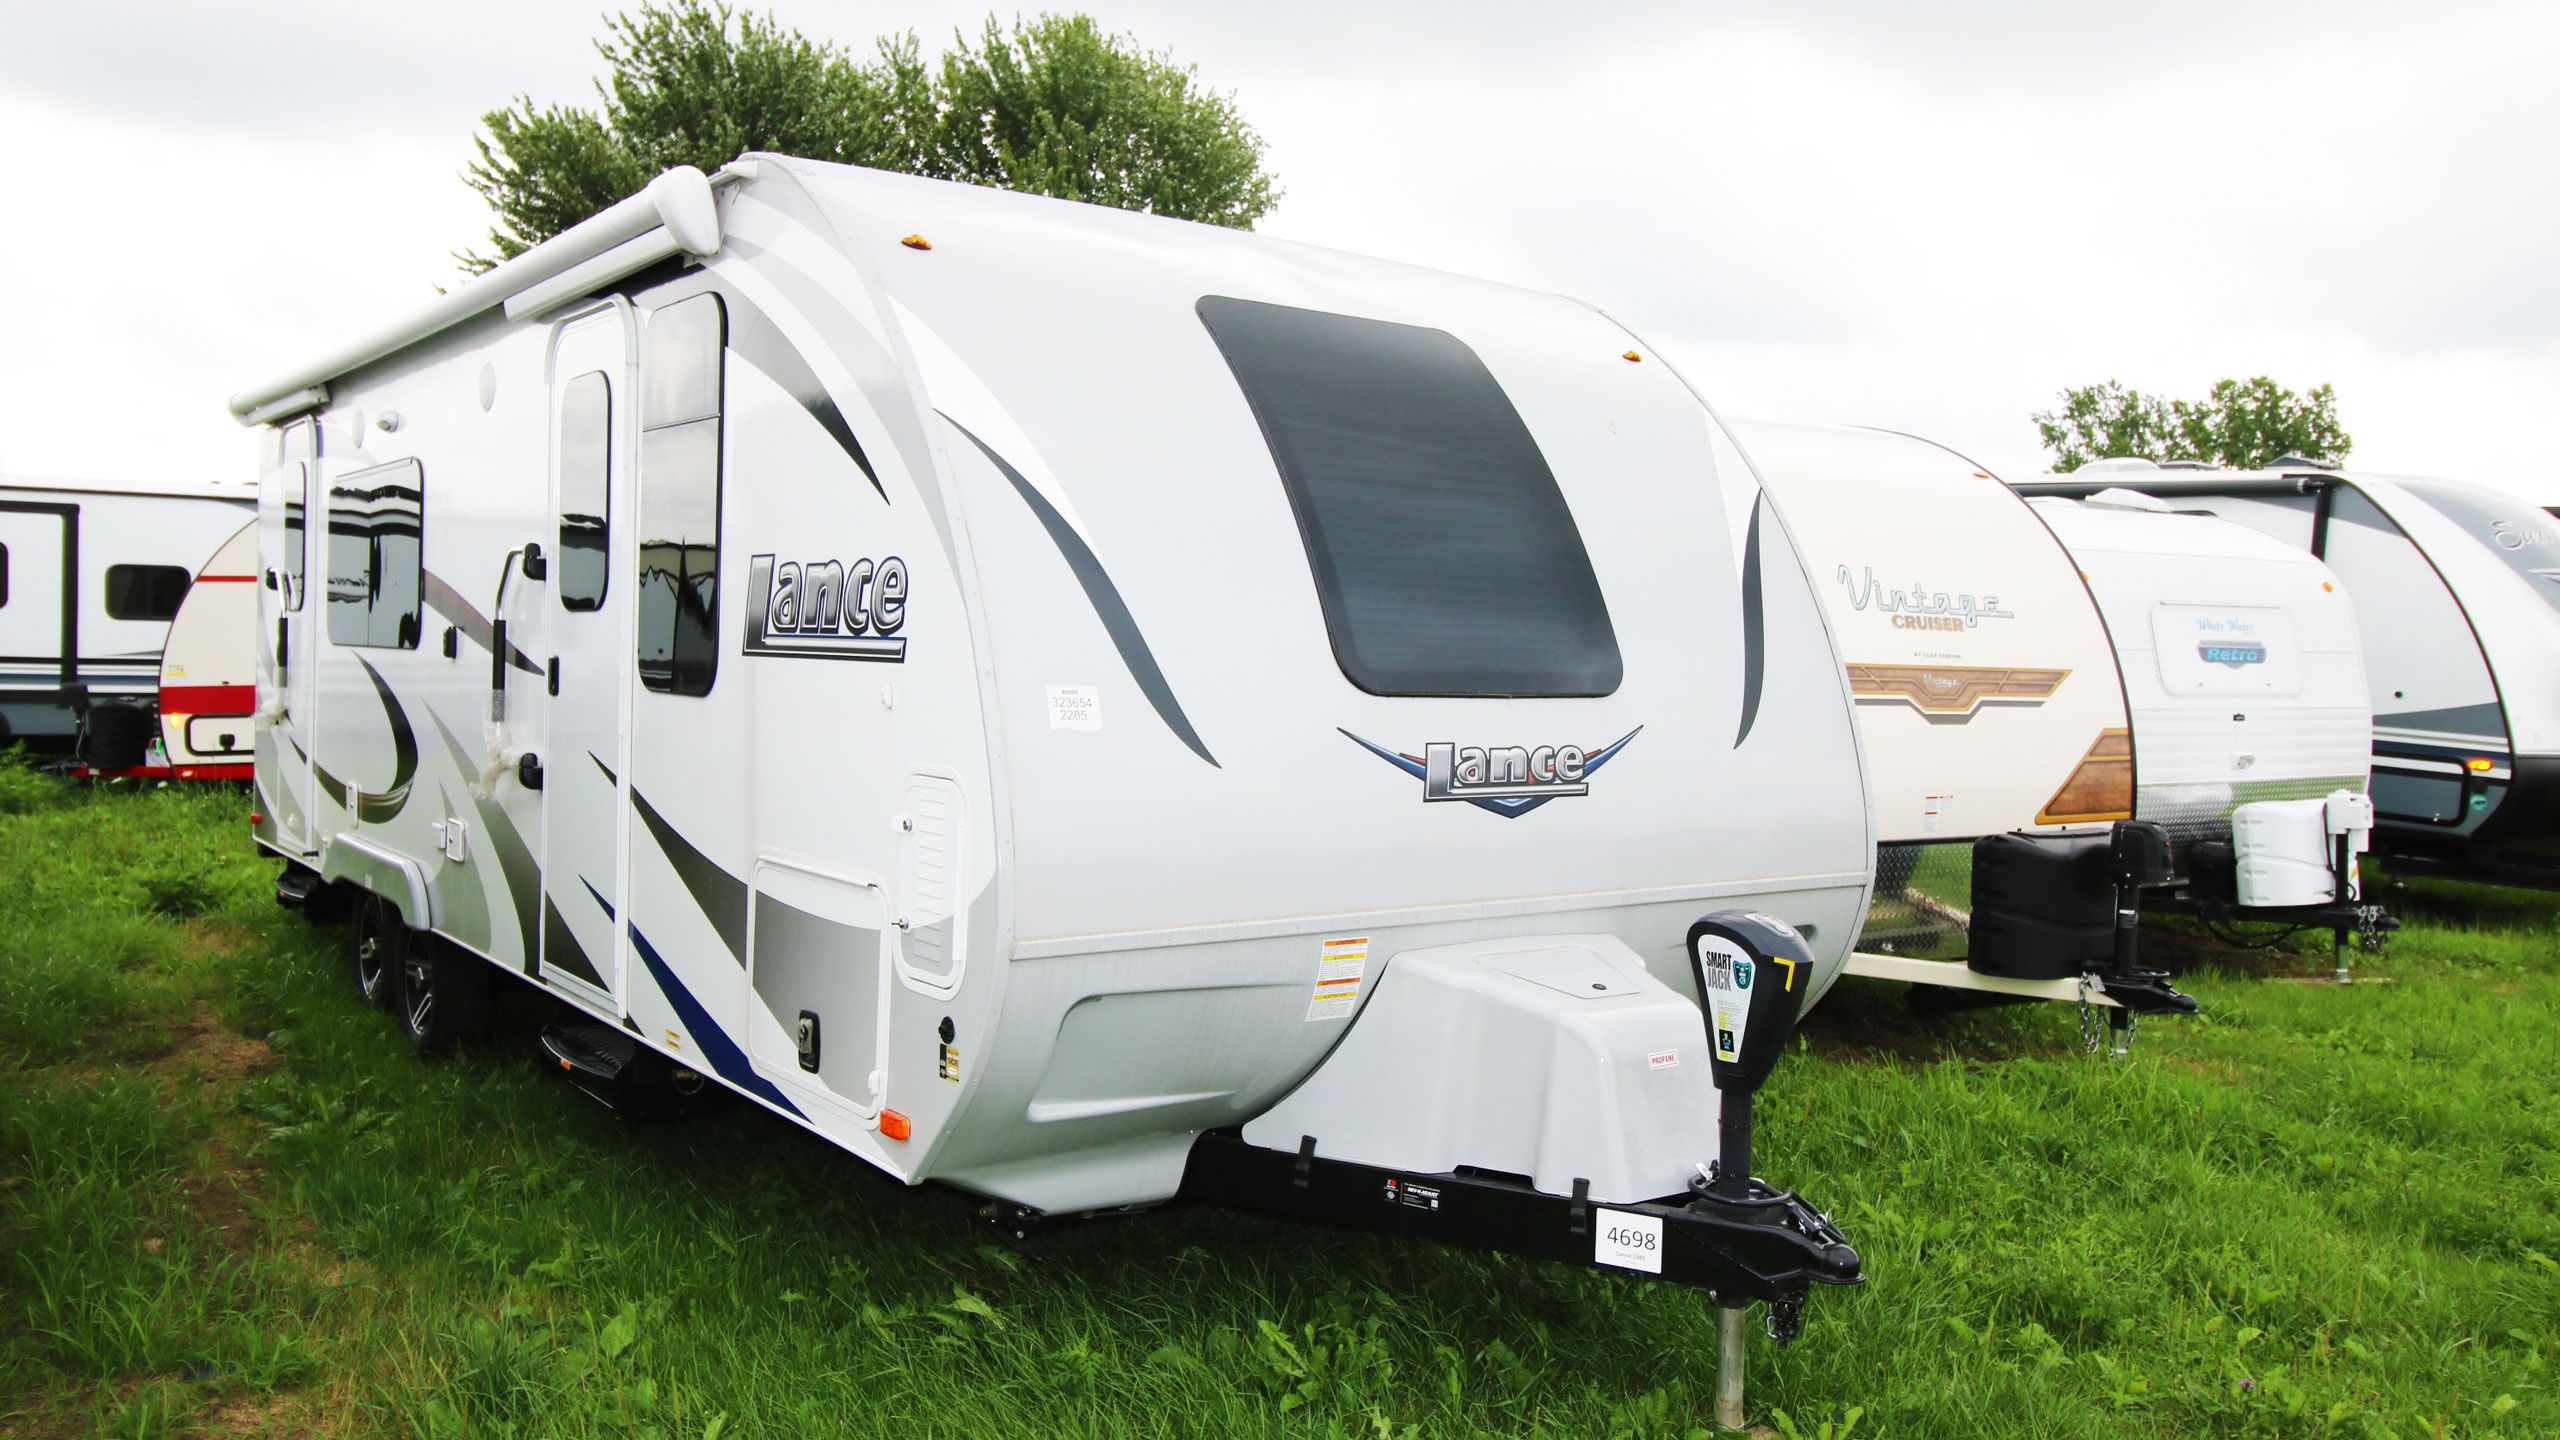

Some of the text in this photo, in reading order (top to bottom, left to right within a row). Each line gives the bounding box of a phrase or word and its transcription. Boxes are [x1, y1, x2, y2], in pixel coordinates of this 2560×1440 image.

[1837, 564, 2014, 628] Vintage
[742, 553, 909, 664] Lance
[1892, 615, 1964, 632] CRUISER
[2195, 616, 2224, 632] White
[2207, 647, 2258, 661] Retro
[1052, 696, 1092, 708] 323654
[1060, 709, 1087, 721] 2285
[1423, 742, 1589, 803] Lance
[1706, 951, 1732, 971] SMART
[1707, 967, 1732, 991] JACK
[1651, 1053, 1675, 1065] PROPANE
[1607, 1227, 1656, 1251] 4698
